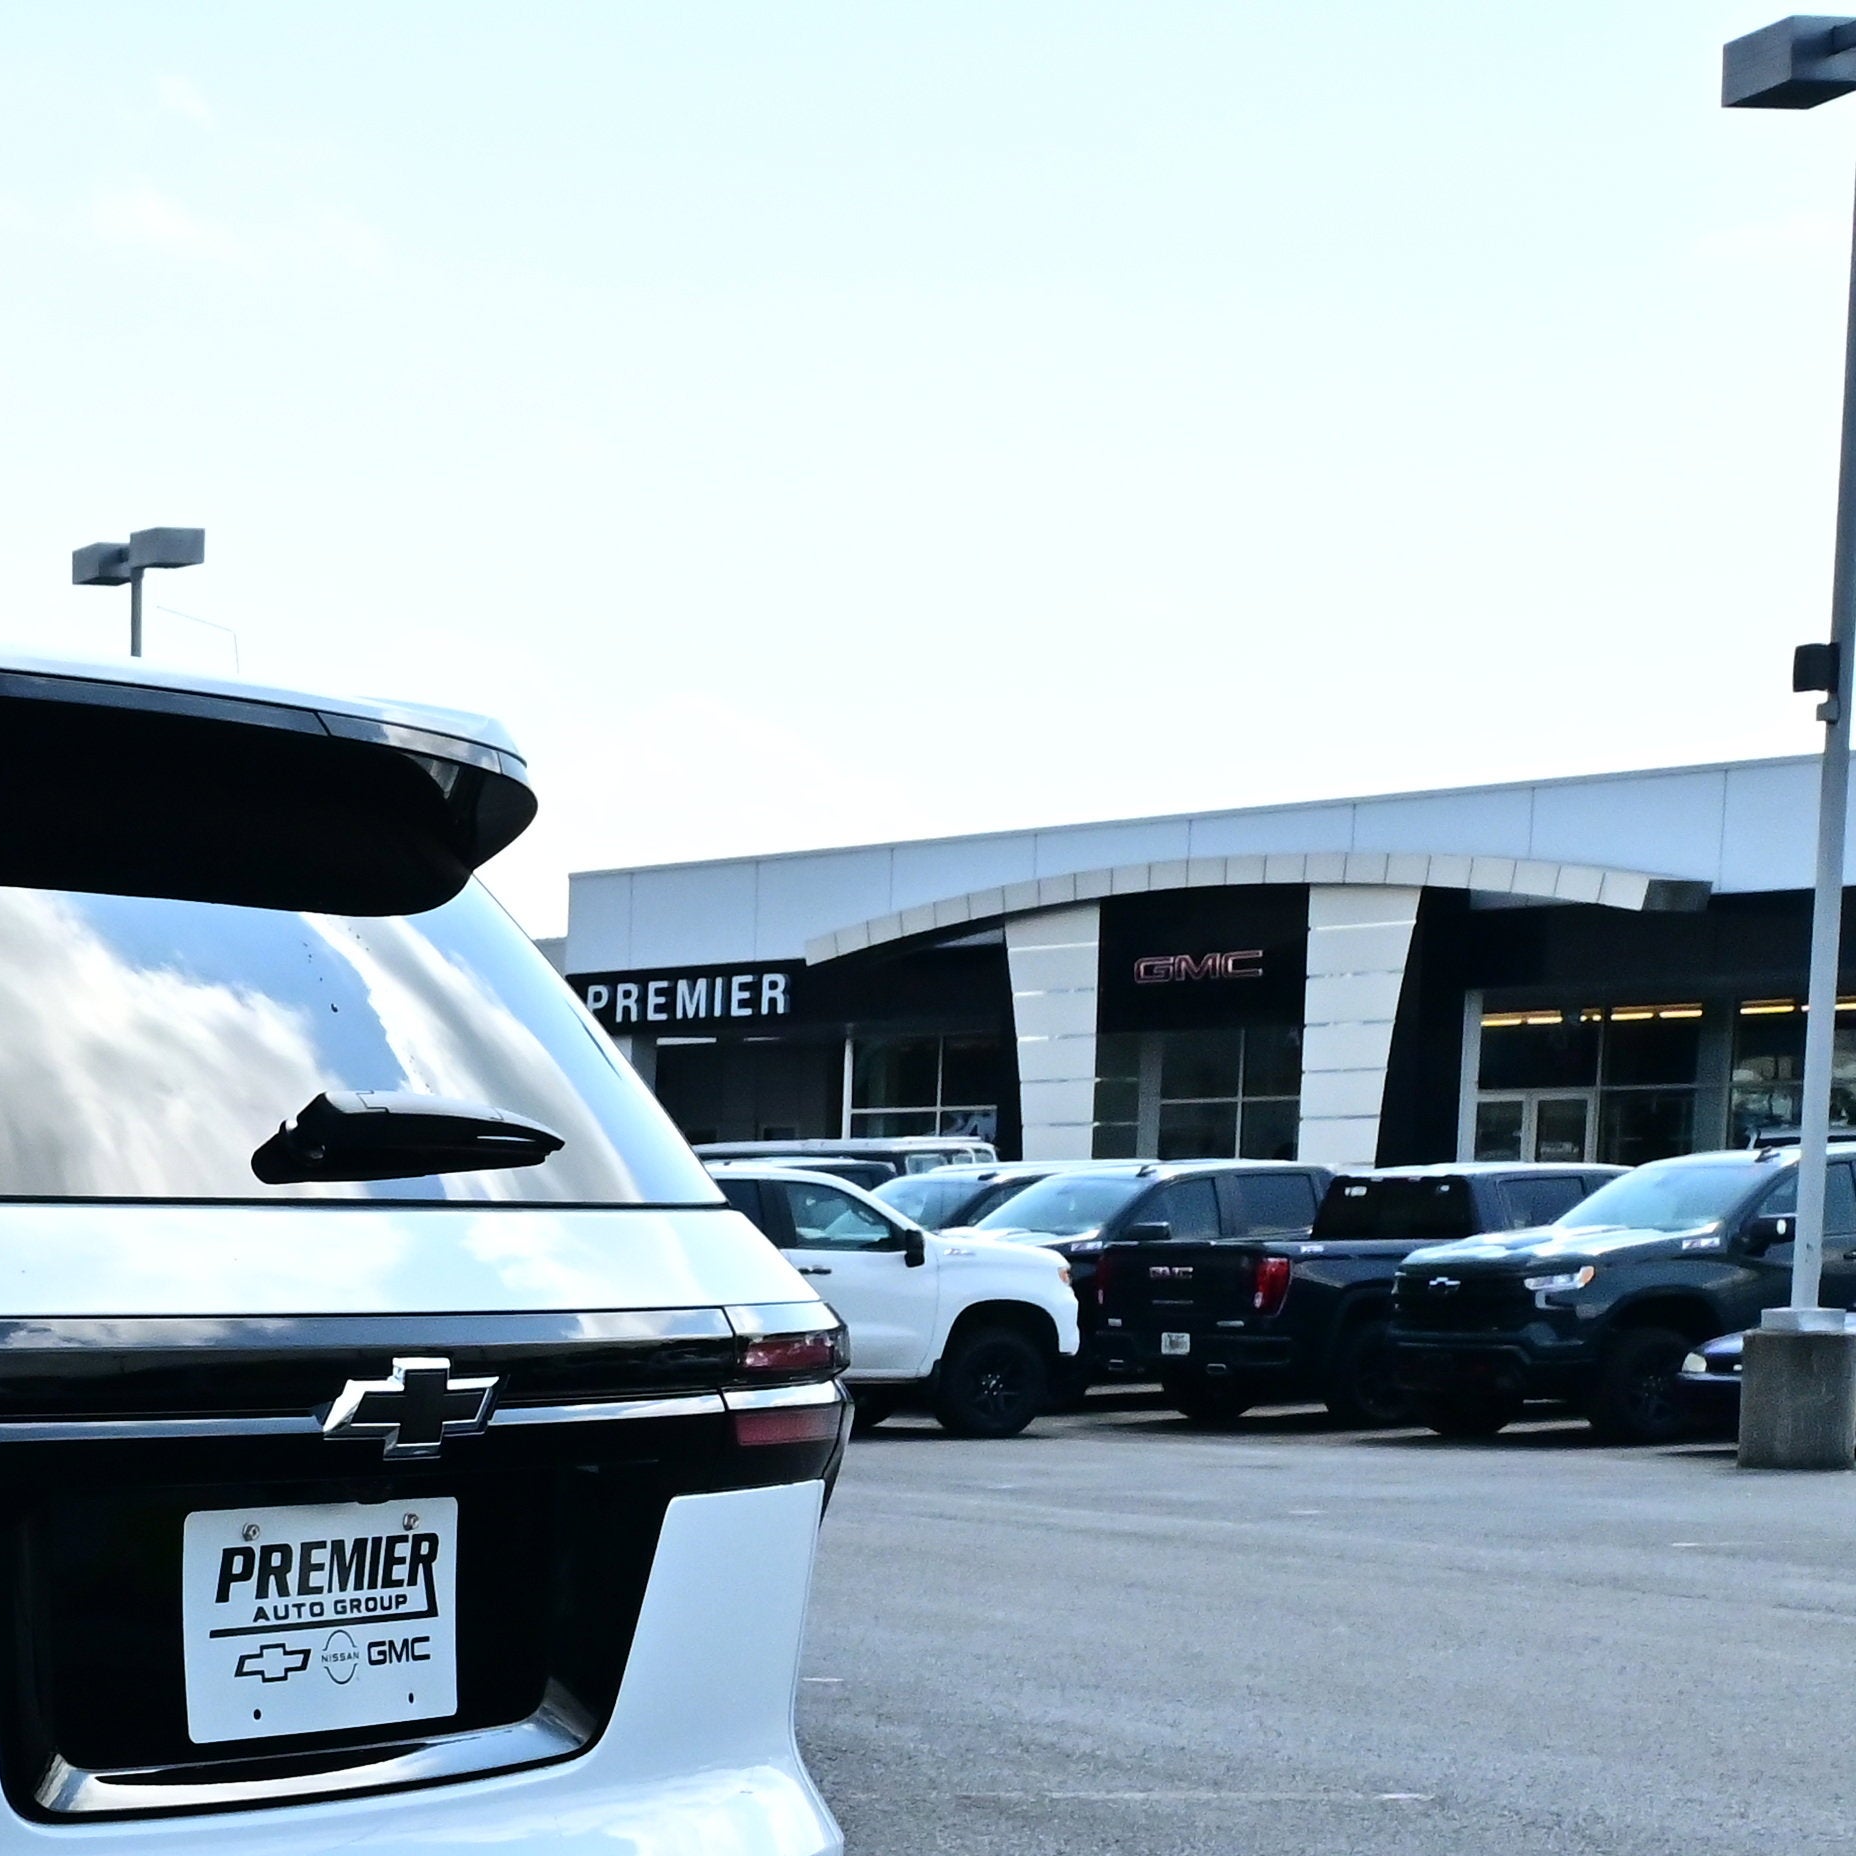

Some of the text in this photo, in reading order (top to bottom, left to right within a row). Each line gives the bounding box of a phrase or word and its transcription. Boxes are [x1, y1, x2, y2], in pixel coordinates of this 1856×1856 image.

[1134, 949, 1263, 984] GMC
[587, 972, 788, 1023] PREMIER
[214, 1532, 440, 1604] PREMIER
[253, 1593, 408, 1623] AUTO GROUP
[321, 1635, 430, 1666] NISSAN GMC
